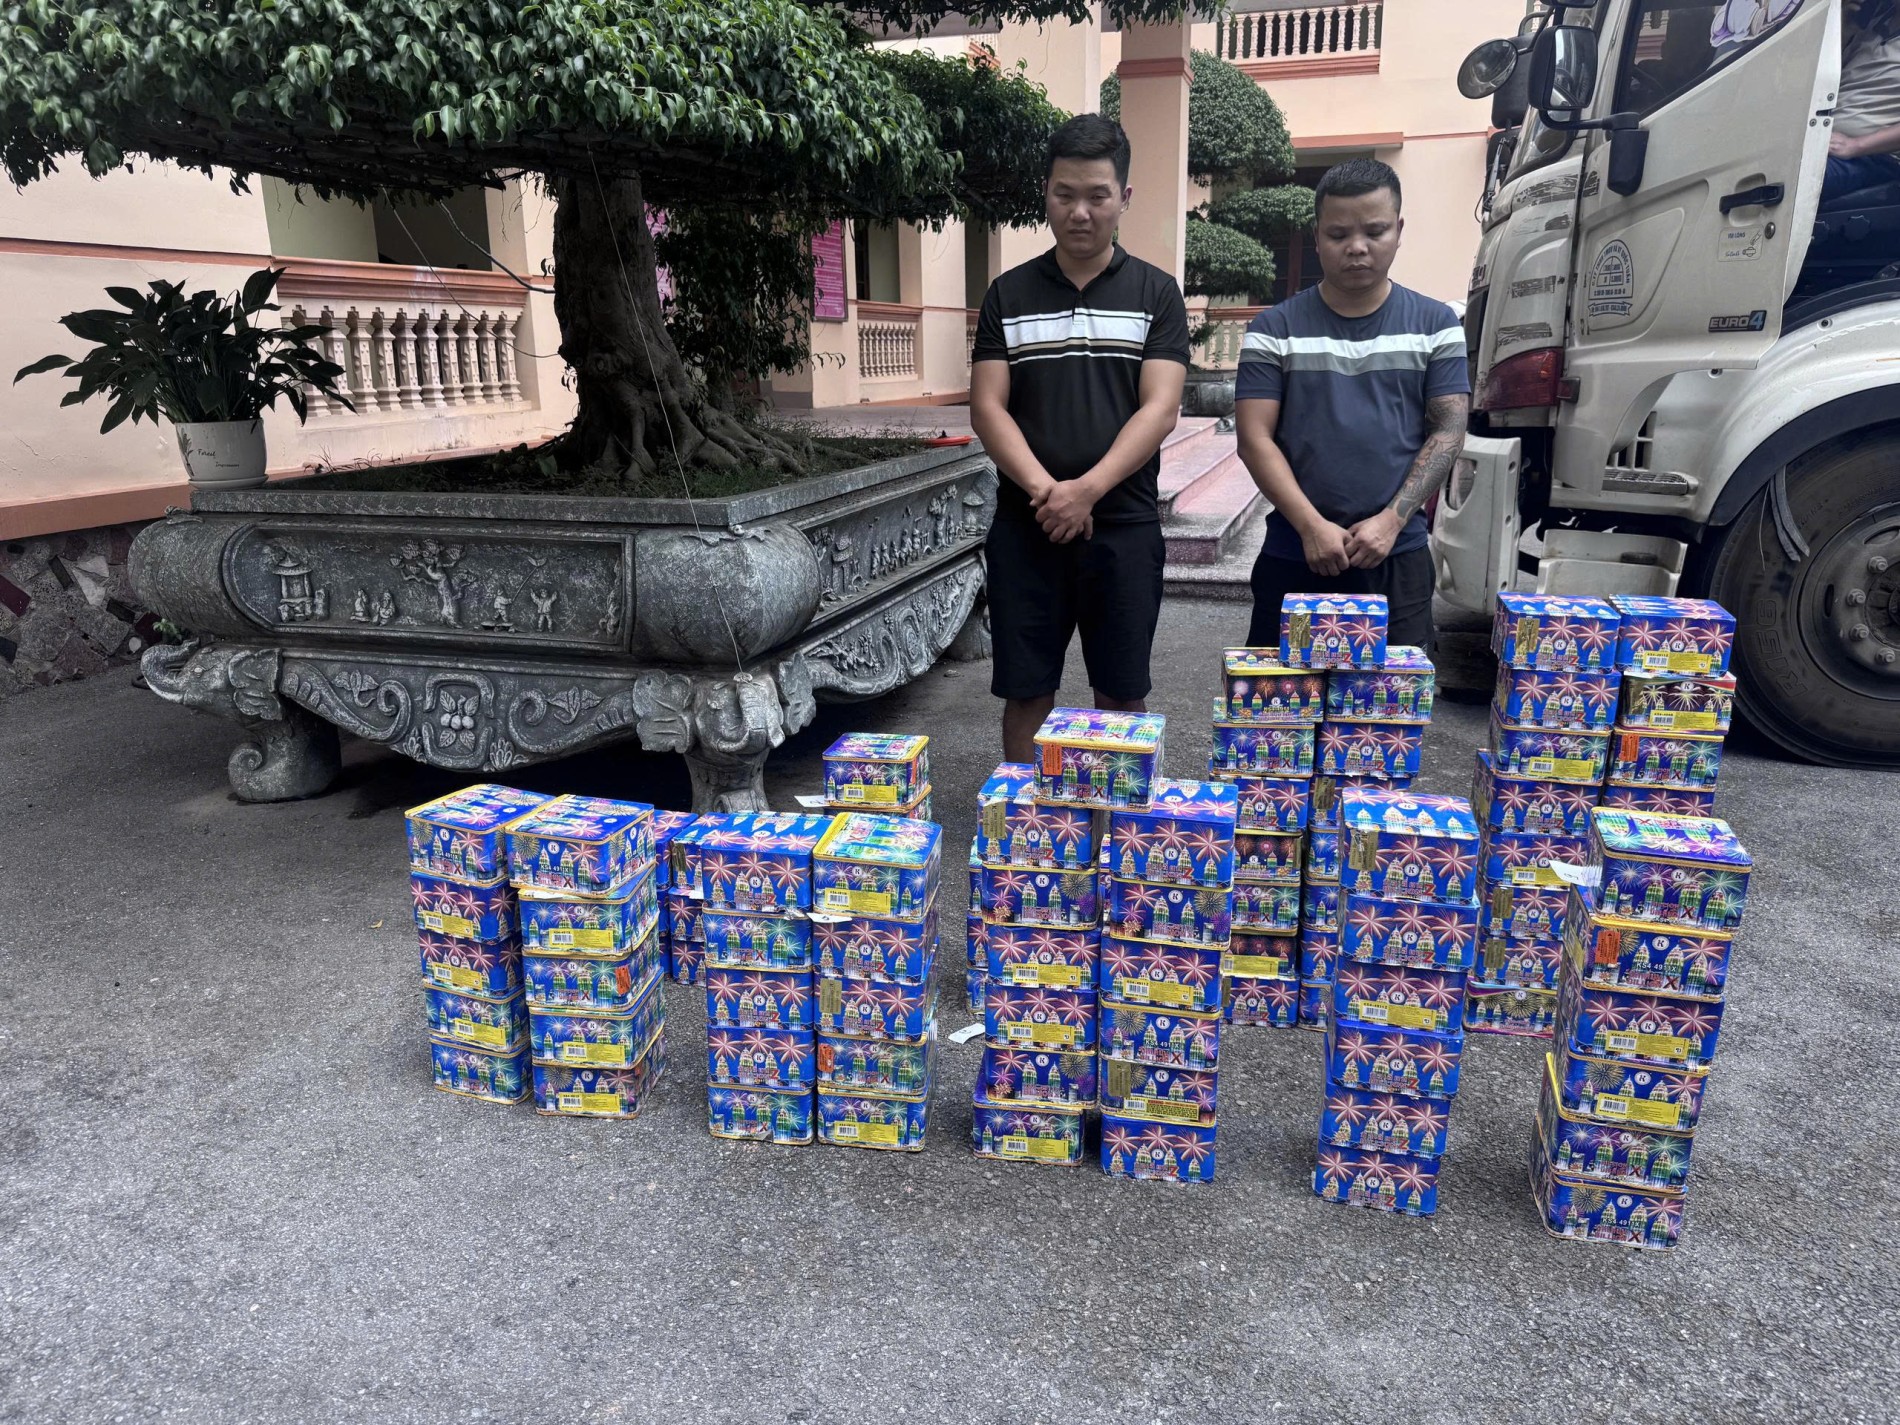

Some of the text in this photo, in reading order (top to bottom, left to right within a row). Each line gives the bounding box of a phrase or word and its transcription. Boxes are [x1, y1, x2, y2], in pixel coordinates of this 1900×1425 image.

[1401, 705, 1408, 713] X
[1282, 758, 1290, 768] X
[1672, 770, 1682, 780] X
[1094, 786, 1104, 798] X
[454, 864, 462, 875] X
[563, 877, 573, 888] X
[1681, 906, 1695, 919] X
[755, 950, 765, 961] X
[1663, 976, 1678, 989] X
[582, 991, 589, 1000] X
[1171, 1052, 1182, 1064] X
[881, 1075, 889, 1084] X
[482, 1082, 489, 1091] X
[760, 1122, 768, 1132] X
[1629, 1165, 1642, 1177] X
[1627, 1231, 1642, 1243] X
